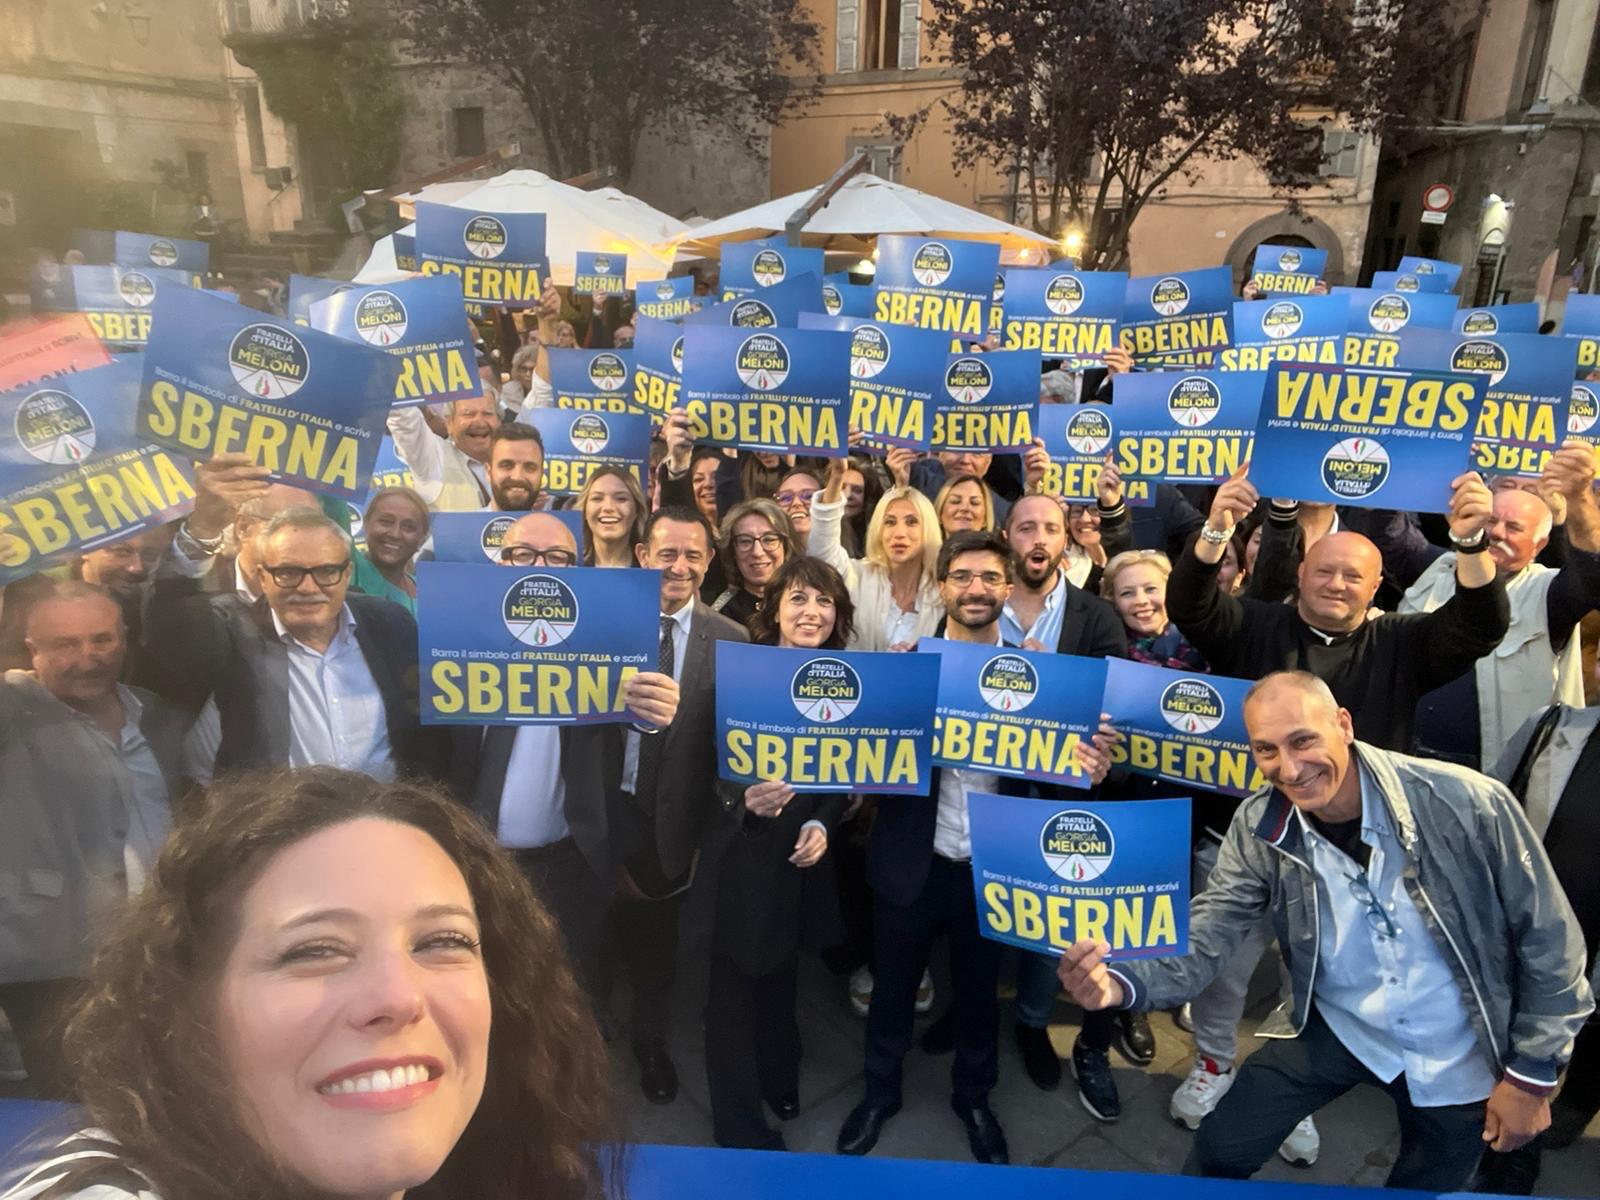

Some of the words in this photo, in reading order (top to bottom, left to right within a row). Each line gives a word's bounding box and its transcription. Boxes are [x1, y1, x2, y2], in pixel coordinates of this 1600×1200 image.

[468, 232, 502, 242] MELONI
[916, 259, 948, 270] MELONI
[576, 276, 623, 293] SBERNA
[1254, 272, 1316, 295] SBERNA
[1049, 291, 1080, 300] MELONI
[1155, 291, 1186, 302] MELONI
[639, 298, 692, 318] SBERNA
[875, 291, 982, 335] SBERNA
[360, 312, 401, 327] MELONI
[86, 312, 152, 341] SBER
[1005, 320, 1112, 354] SBERNA
[1120, 317, 1229, 356] SBERNA
[415, 343, 438, 351] ITALIA
[1343, 337, 1400, 367] BER
[238, 349, 300, 376] MELONI
[742, 358, 784, 369] MELONI
[1457, 359, 1502, 370] MELONI
[394, 350, 474, 399] RNA
[950, 377, 987, 385] MELONI
[634, 370, 682, 415] SBE
[884, 385, 906, 396] ITALIA
[750, 393, 781, 401] FRATELLI
[791, 396, 813, 404] ITALIA
[821, 398, 840, 406] scrivi
[1174, 397, 1215, 408] MELONI
[1277, 370, 1475, 431] SBERNA
[228, 392, 239, 403] di
[240, 398, 288, 416] FRATELLI
[300, 412, 333, 428] ITALIA
[344, 423, 371, 439] scrivi
[849, 389, 924, 441] RNA
[686, 399, 840, 448] SBERNA
[930, 411, 1033, 446] BERNA
[1268, 419, 1291, 428] scrivi
[1300, 422, 1328, 431] ITALIA
[1474, 400, 1556, 444] RNA
[26, 416, 87, 444] MELONI
[147, 380, 359, 490] SBERNA
[1071, 427, 1107, 437] MELONI
[1172, 429, 1179, 437] di
[1220, 429, 1242, 437] ITALIA
[1340, 425, 1380, 436] FRATELLI
[1380, 427, 1391, 436] di
[1392, 428, 1430, 439] simbolo
[1330, 460, 1382, 475] MELONI
[523, 581, 558, 589] FRATELLI
[520, 588, 562, 596] d'ITALIA
[519, 598, 562, 606] GIORGIA
[511, 606, 569, 618] MELONI
[431, 648, 459, 658] Barra
[468, 649, 509, 660] simbolo
[511, 651, 521, 660] di
[523, 652, 566, 661] FRATELLI
[580, 653, 611, 662] ITALIA
[621, 654, 648, 663] scrivi
[812, 663, 844, 671] FRATELLI
[808, 670, 846, 678] d'ITALIA
[806, 678, 847, 686] GIORGIA
[985, 677, 1032, 691] MELONI
[800, 685, 854, 697] MELONI
[1167, 700, 1217, 715] MELONI
[726, 718, 751, 729] Barra
[758, 722, 796, 734] simbolo
[797, 724, 807, 735] di
[808, 727, 848, 735] FRATELLI
[861, 727, 890, 736] ITALIA
[900, 727, 924, 736] scrivi
[980, 712, 989, 720] di
[990, 713, 1024, 725] FRATELLI
[1035, 719, 1060, 729] ITALIA
[1175, 734, 1211, 745] FRATELLI
[1223, 741, 1251, 751] ITALIA
[726, 729, 919, 784] SBERNA
[1060, 816, 1094, 824] FRATELLI
[1056, 823, 1097, 832] d'ITALIA
[1055, 832, 1098, 841] GIORGIA
[1048, 840, 1106, 853] MELONI
[983, 870, 1006, 883] Barra
[1013, 875, 1048, 891] simbolo
[1049, 882, 1059, 893] di
[1060, 885, 1104, 896] FRATELLI
[1116, 884, 1146, 895] ITALIA
[1155, 881, 1179, 892] scrivi
[984, 882, 1178, 950] SBERNA
